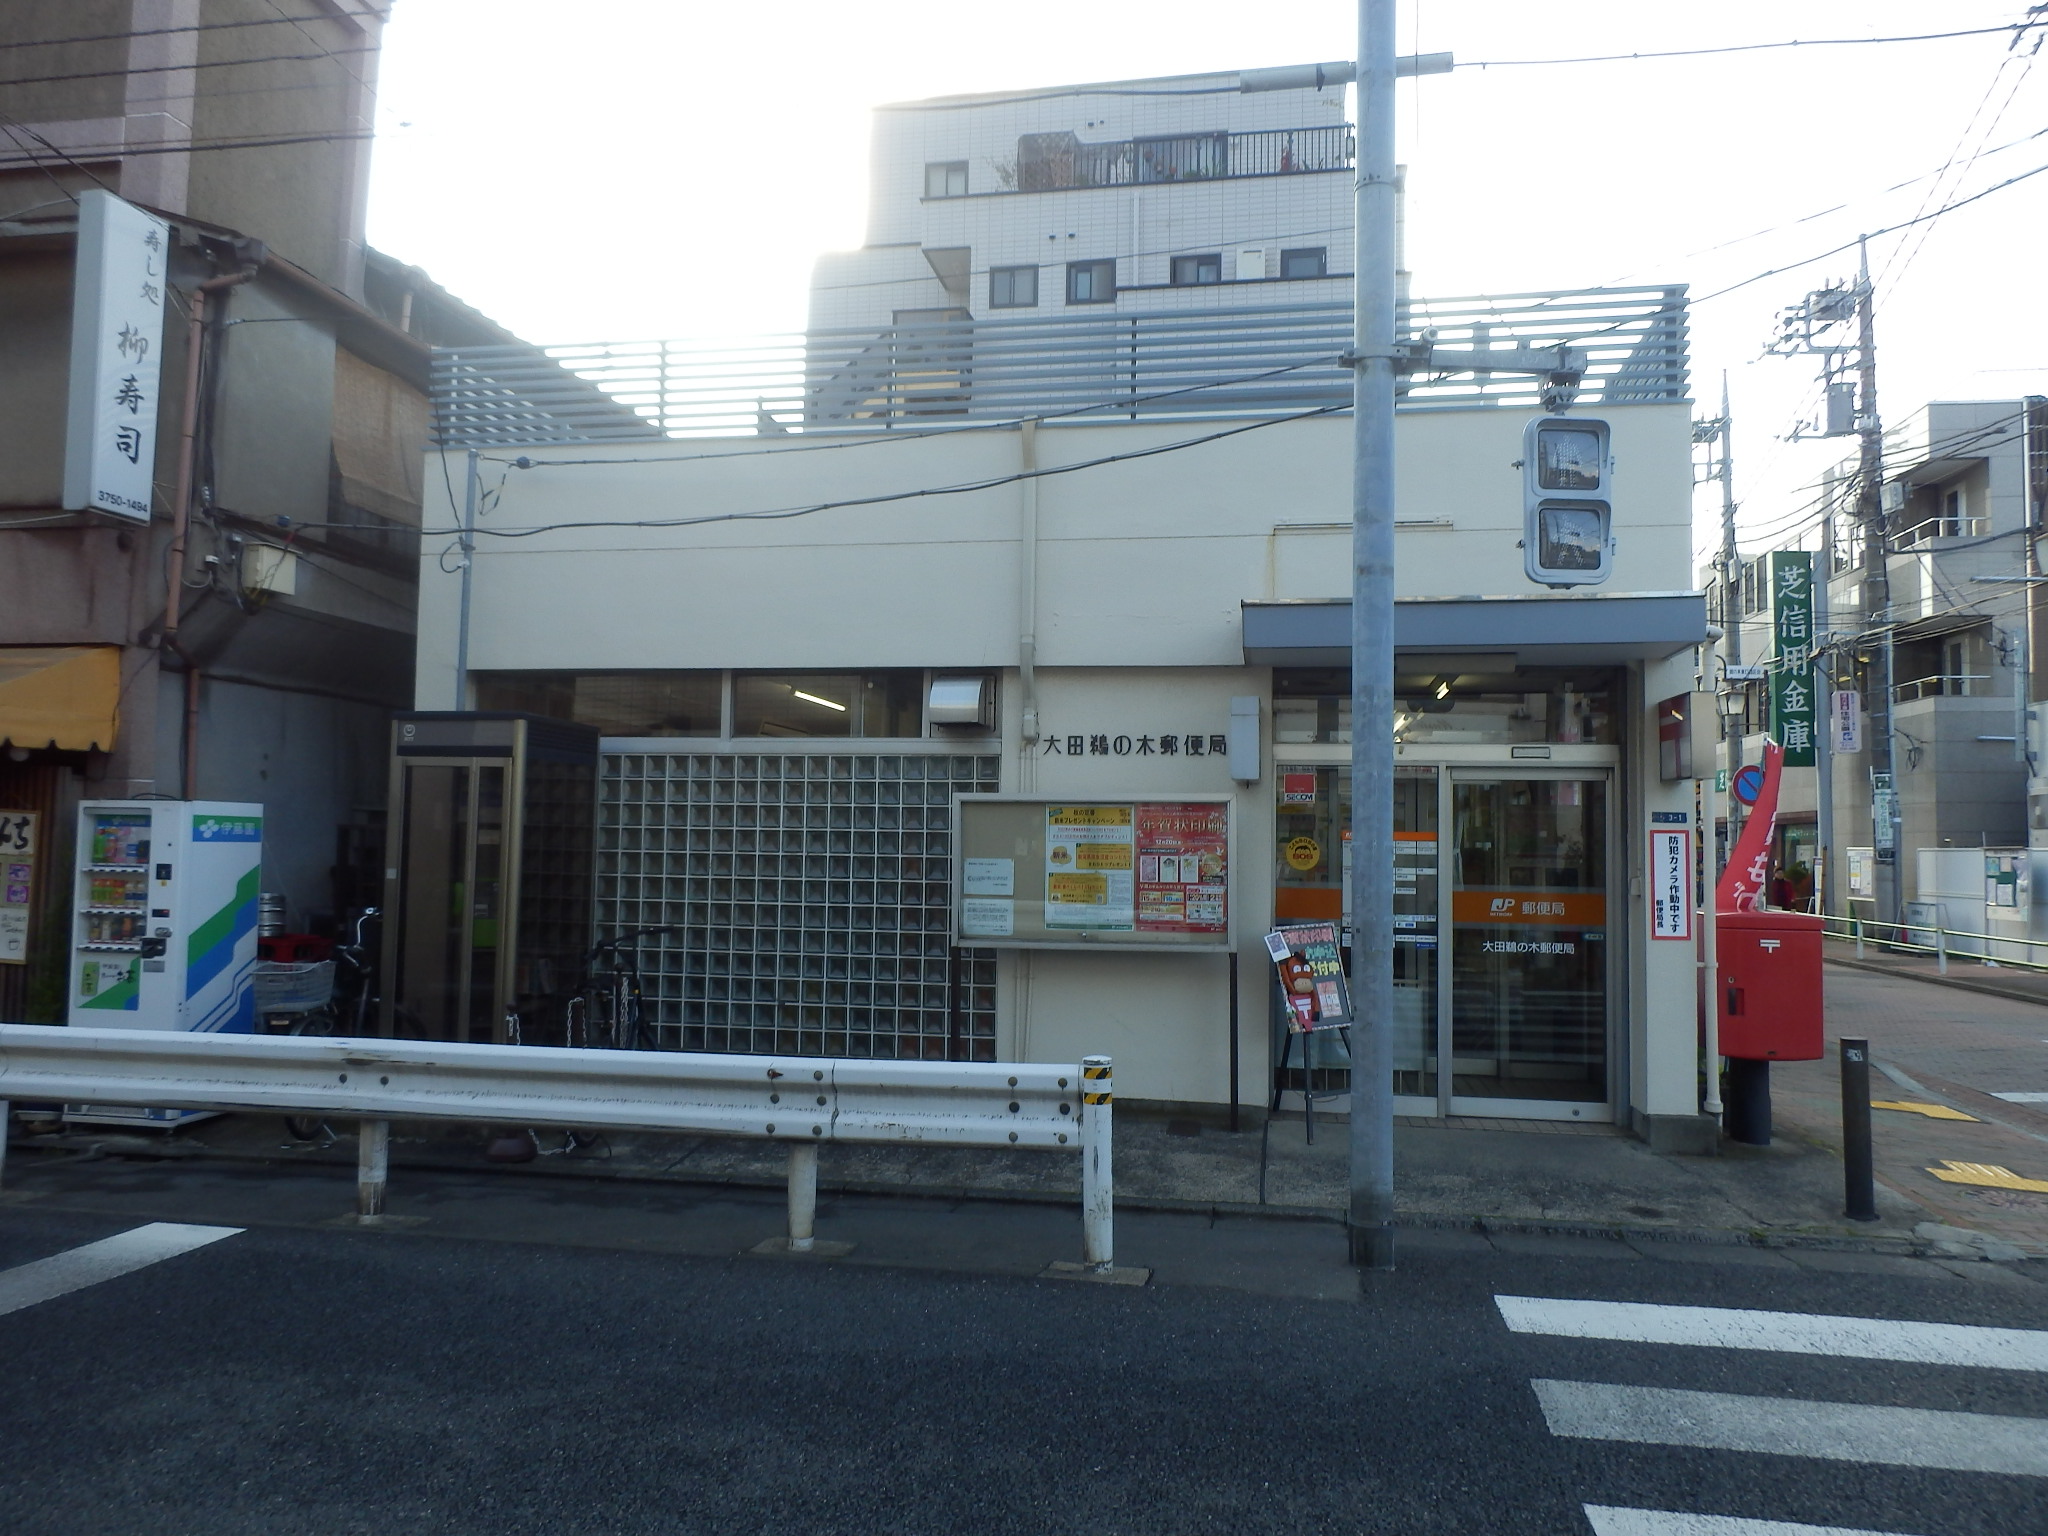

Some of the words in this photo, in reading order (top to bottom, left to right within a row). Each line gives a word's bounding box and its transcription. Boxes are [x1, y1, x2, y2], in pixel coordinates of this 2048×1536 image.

[139, 228, 163, 306] 寿し処
[114, 321, 149, 464] 柳寿司
[1777, 565, 1812, 753] 芝信用金庫
[1043, 733, 1228, 757] 大田鵜の木郵便局
[1141, 817, 1223, 833] 年賀状印刷
[1668, 835, 1680, 933] 防犯カメラ作動中です
[1521, 901, 1565, 916] 郵便局
[1656, 899, 1664, 928] 郵便局長
[1482, 940, 1575, 955] 大田鵜の木郵便局
